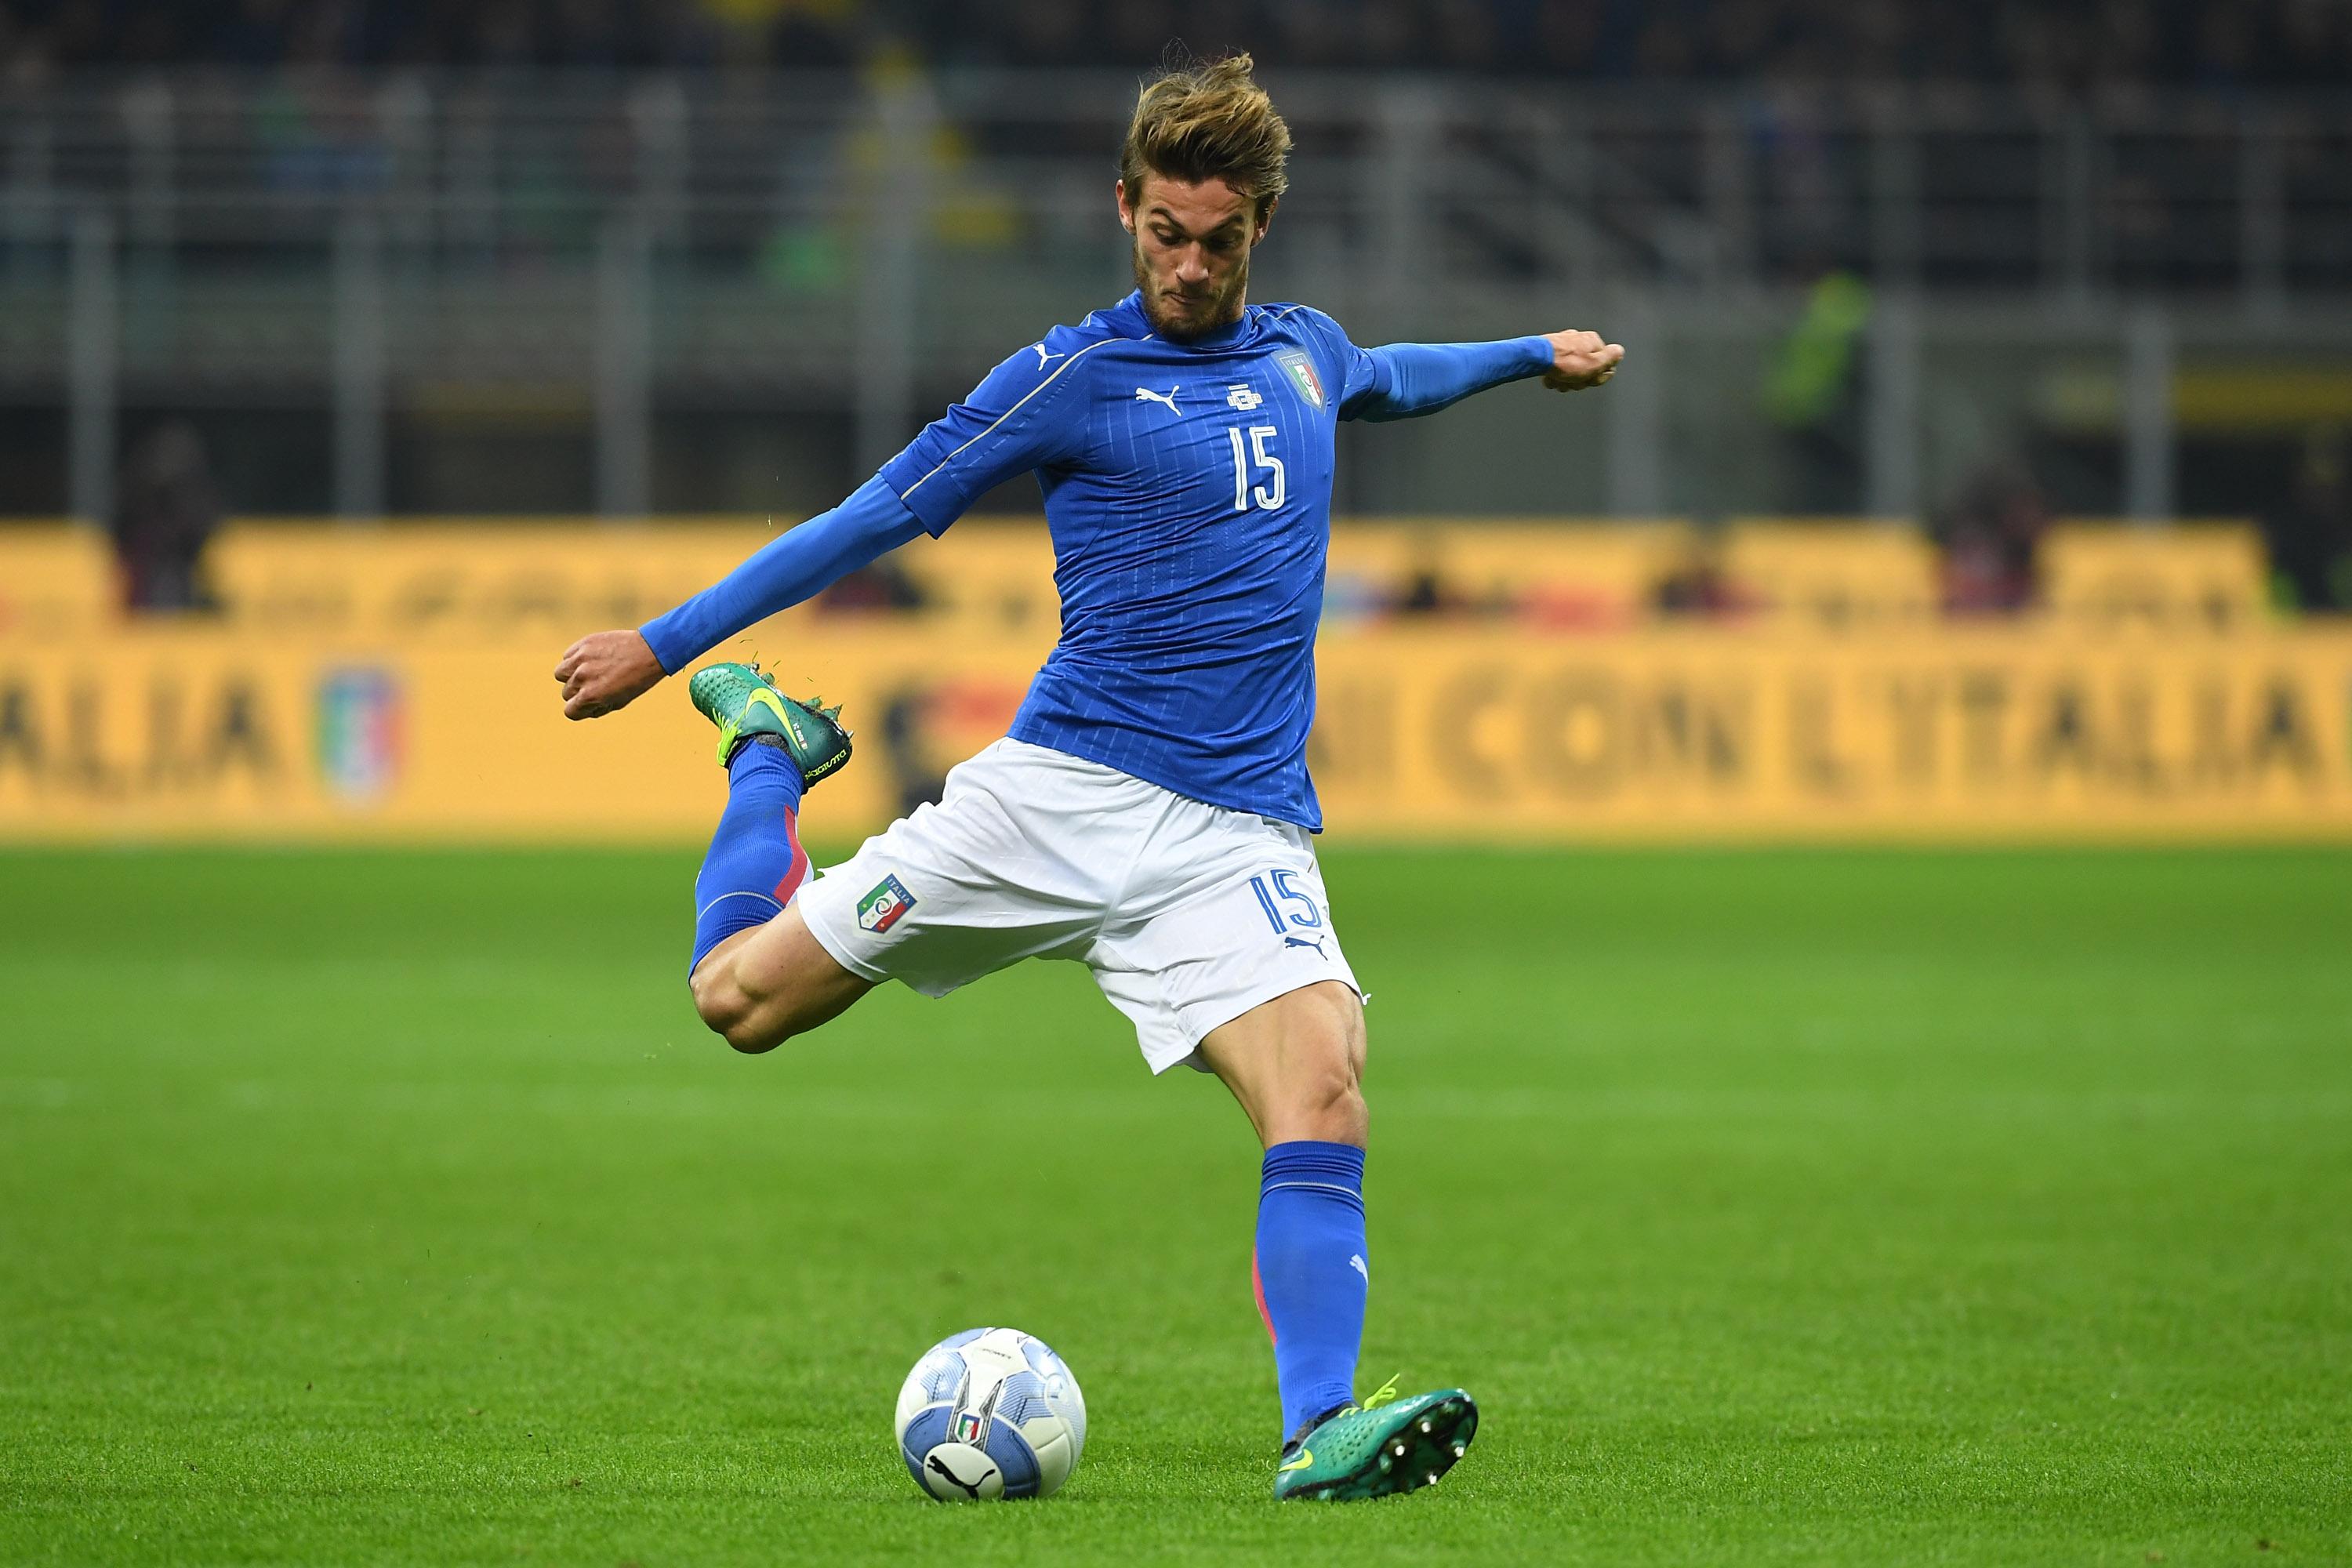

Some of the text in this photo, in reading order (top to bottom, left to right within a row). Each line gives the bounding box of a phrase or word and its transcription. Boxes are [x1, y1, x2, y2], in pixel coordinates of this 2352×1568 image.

[1229, 426, 1286, 511] 15
[1428, 665, 1755, 798] CON
[887, 878, 910, 904] ITALIA
[1249, 869, 1322, 935] 15
